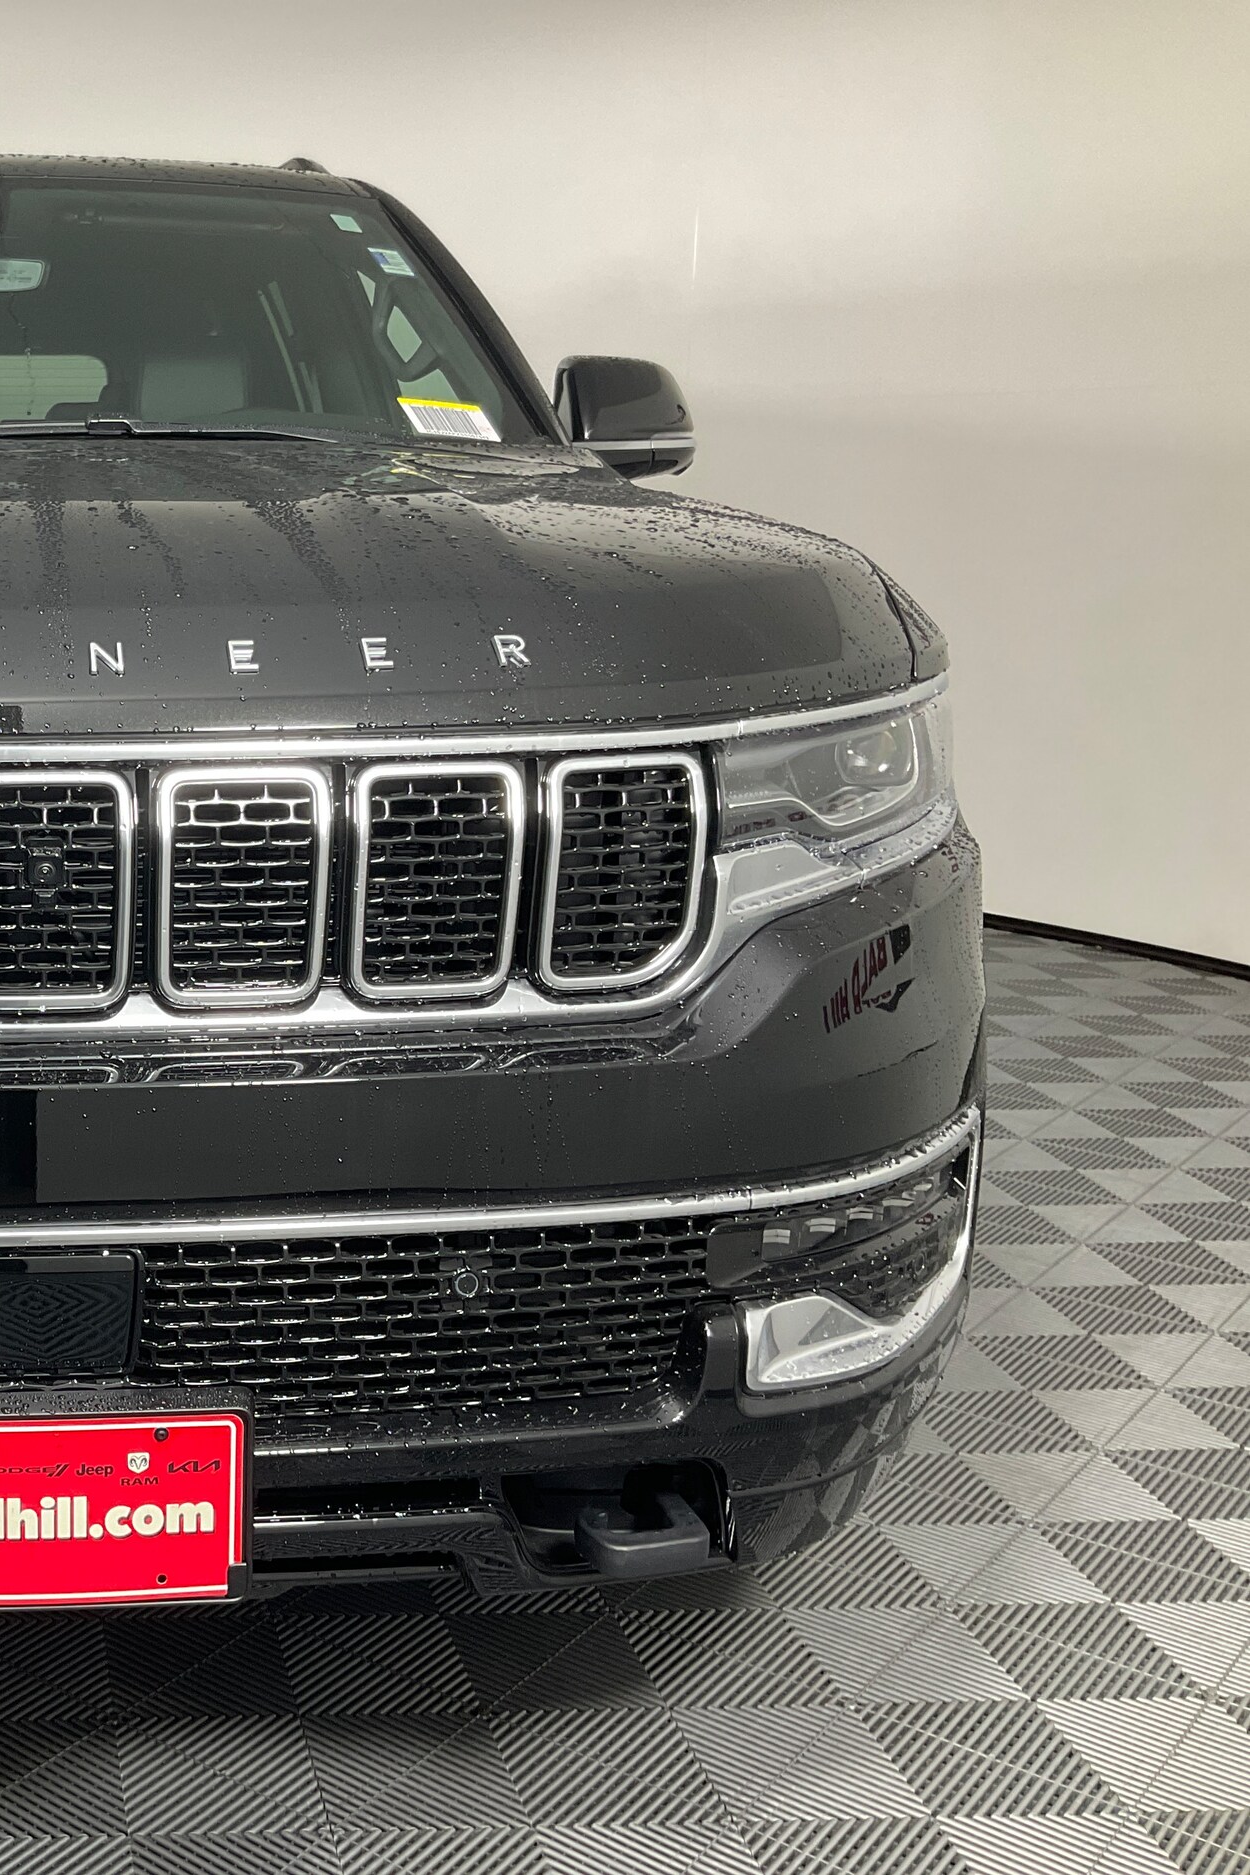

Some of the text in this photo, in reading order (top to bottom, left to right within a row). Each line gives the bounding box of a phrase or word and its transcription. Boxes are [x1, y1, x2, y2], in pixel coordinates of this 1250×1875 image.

[76, 1463, 114, 1477] Jeep
[168, 1459, 221, 1474] KIA
[120, 1477, 159, 1487] RAM
